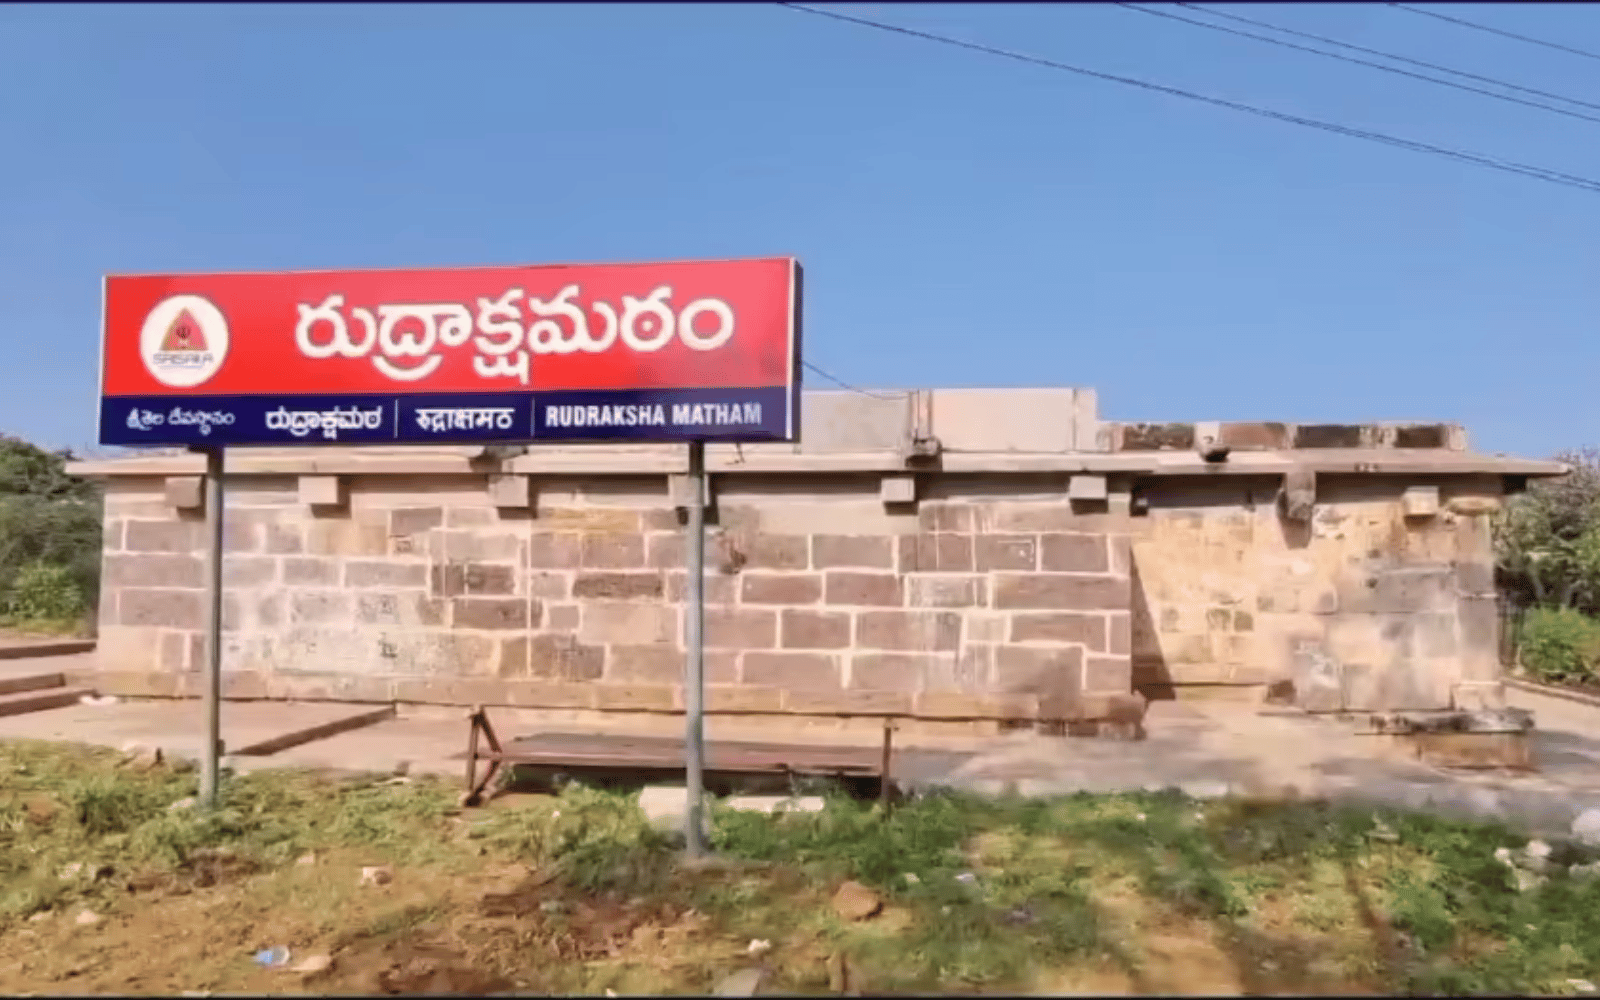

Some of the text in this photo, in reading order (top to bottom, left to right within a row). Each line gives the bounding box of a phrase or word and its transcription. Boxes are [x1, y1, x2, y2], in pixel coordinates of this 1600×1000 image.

[296, 284, 735, 385] రుద్రాక్షమఠం
[167, 406, 236, 436] దేవస్థానం
[414, 407, 515, 433] रुद्राक्षमठ
[545, 402, 763, 427] RUDRAKSHA MATHAM
